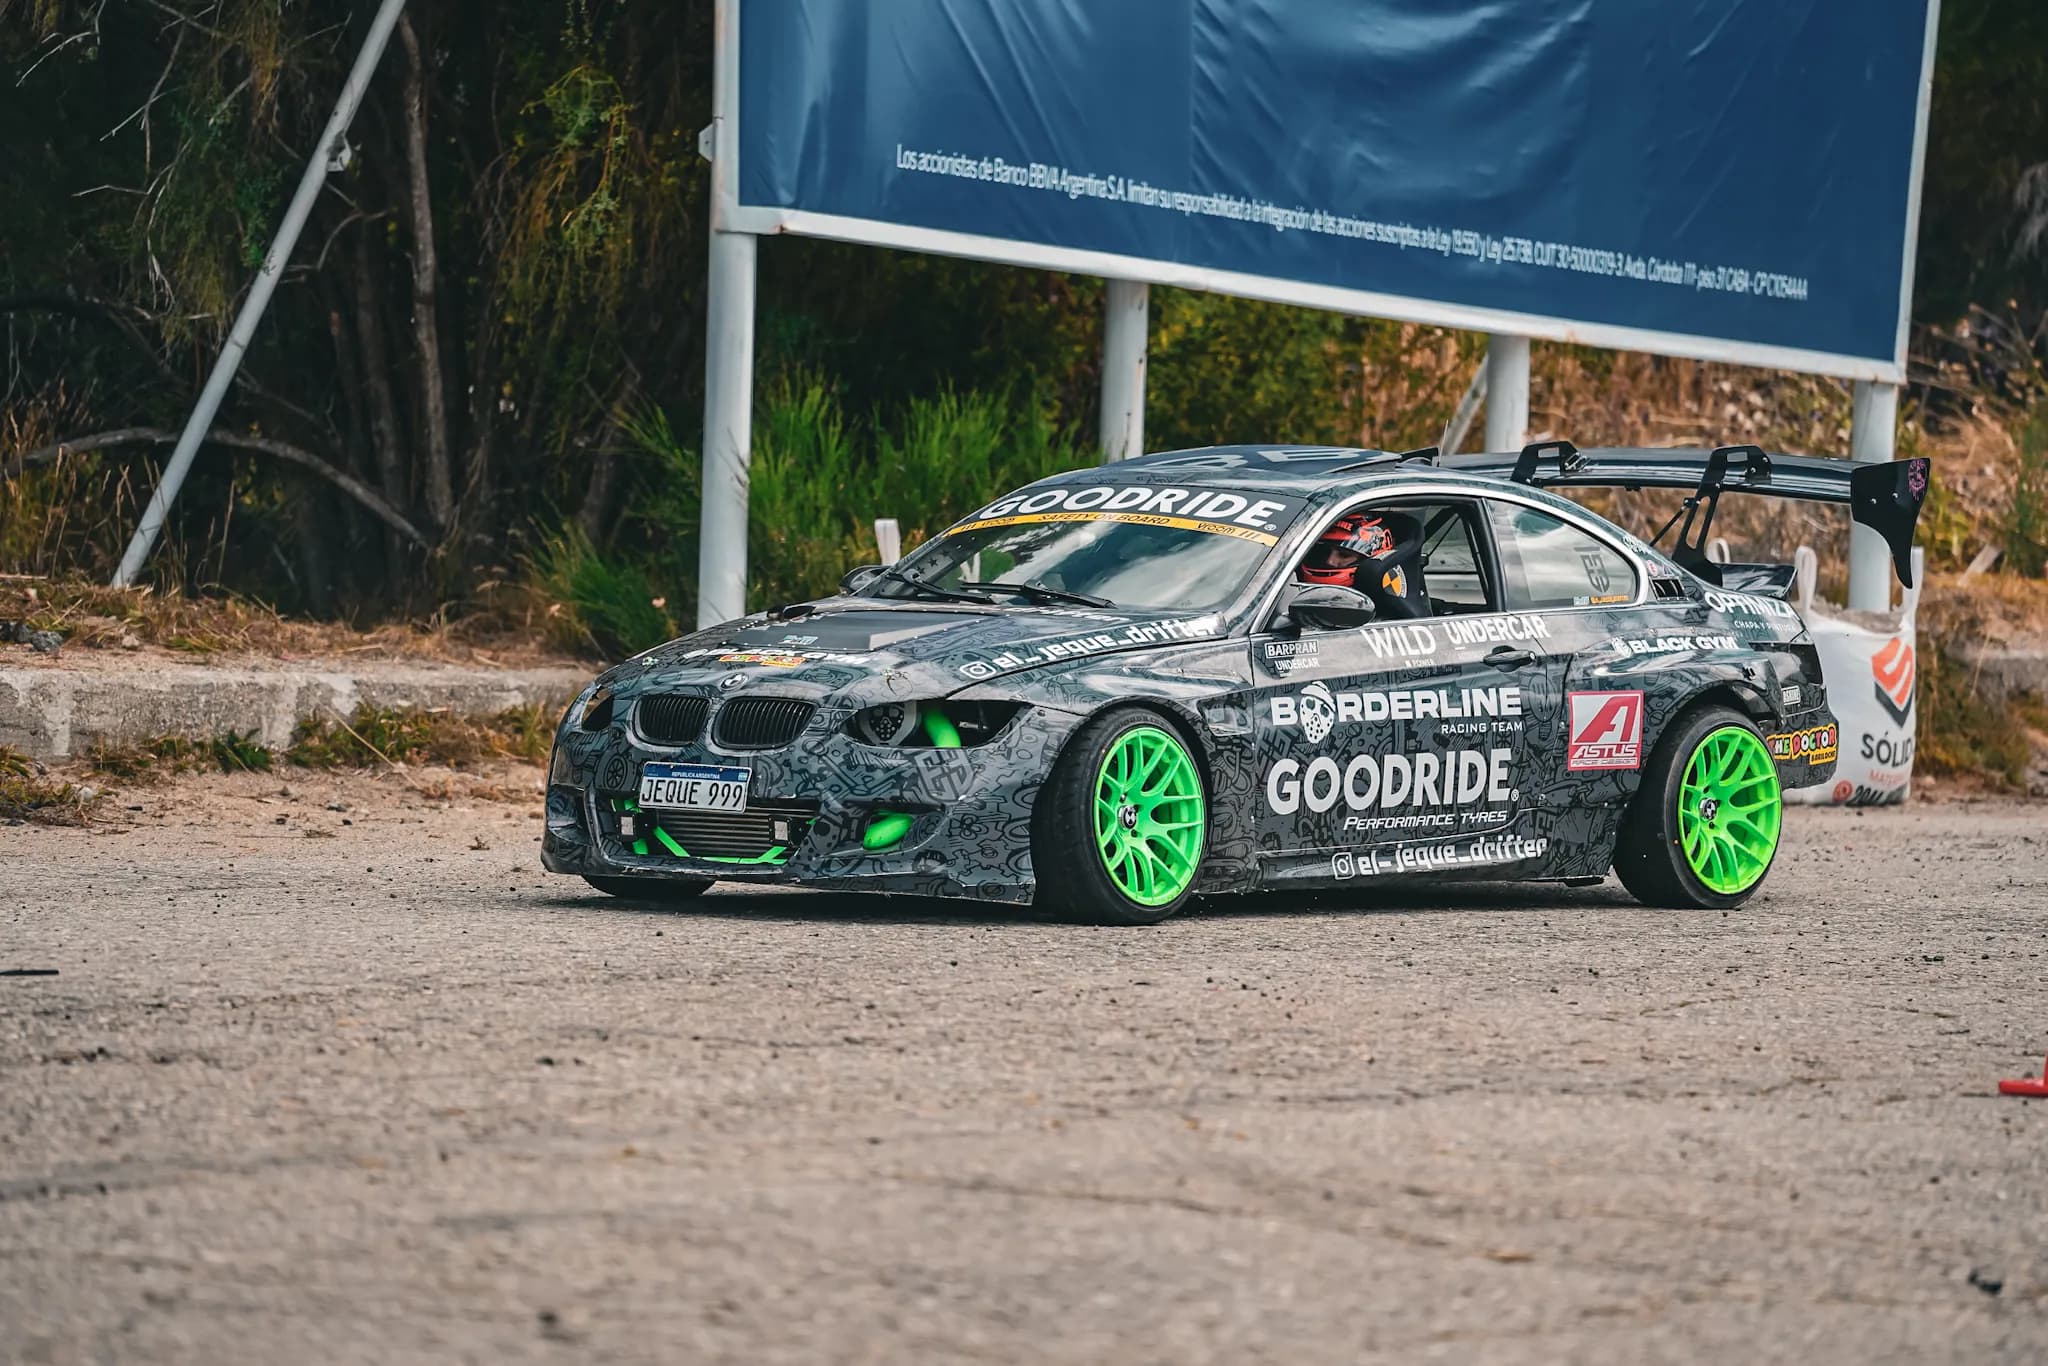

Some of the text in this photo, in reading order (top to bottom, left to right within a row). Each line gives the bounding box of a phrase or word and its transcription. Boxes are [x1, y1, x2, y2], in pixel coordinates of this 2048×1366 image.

[896, 144, 917, 170] Los
[978, 156, 993, 181] de
[993, 157, 1027, 186] Banco
[1028, 162, 1058, 190] BBVA
[1058, 168, 1107, 199] Argentina
[978, 486, 1286, 528] GOODRIDE
[1038, 512, 1097, 522] SAFETY
[1097, 512, 1116, 522] ON
[1116, 514, 1170, 526] BOARD
[1361, 616, 1551, 659] WILD UNDERCAR
[1629, 637, 1740, 653] BLACK GYM
[1267, 642, 1318, 657] BARPRAN
[1275, 657, 1321, 671] UNDERCAR
[1441, 720, 1524, 734] RACING TEAM
[1572, 744, 1638, 758] ASTUS
[1768, 727, 1836, 755] THE DOCTOR
[1267, 748, 1513, 815] GOODRIDE
[641, 779, 743, 807] JEQUE 999
[1343, 810, 1508, 831] PERFORMANCE TYRES
